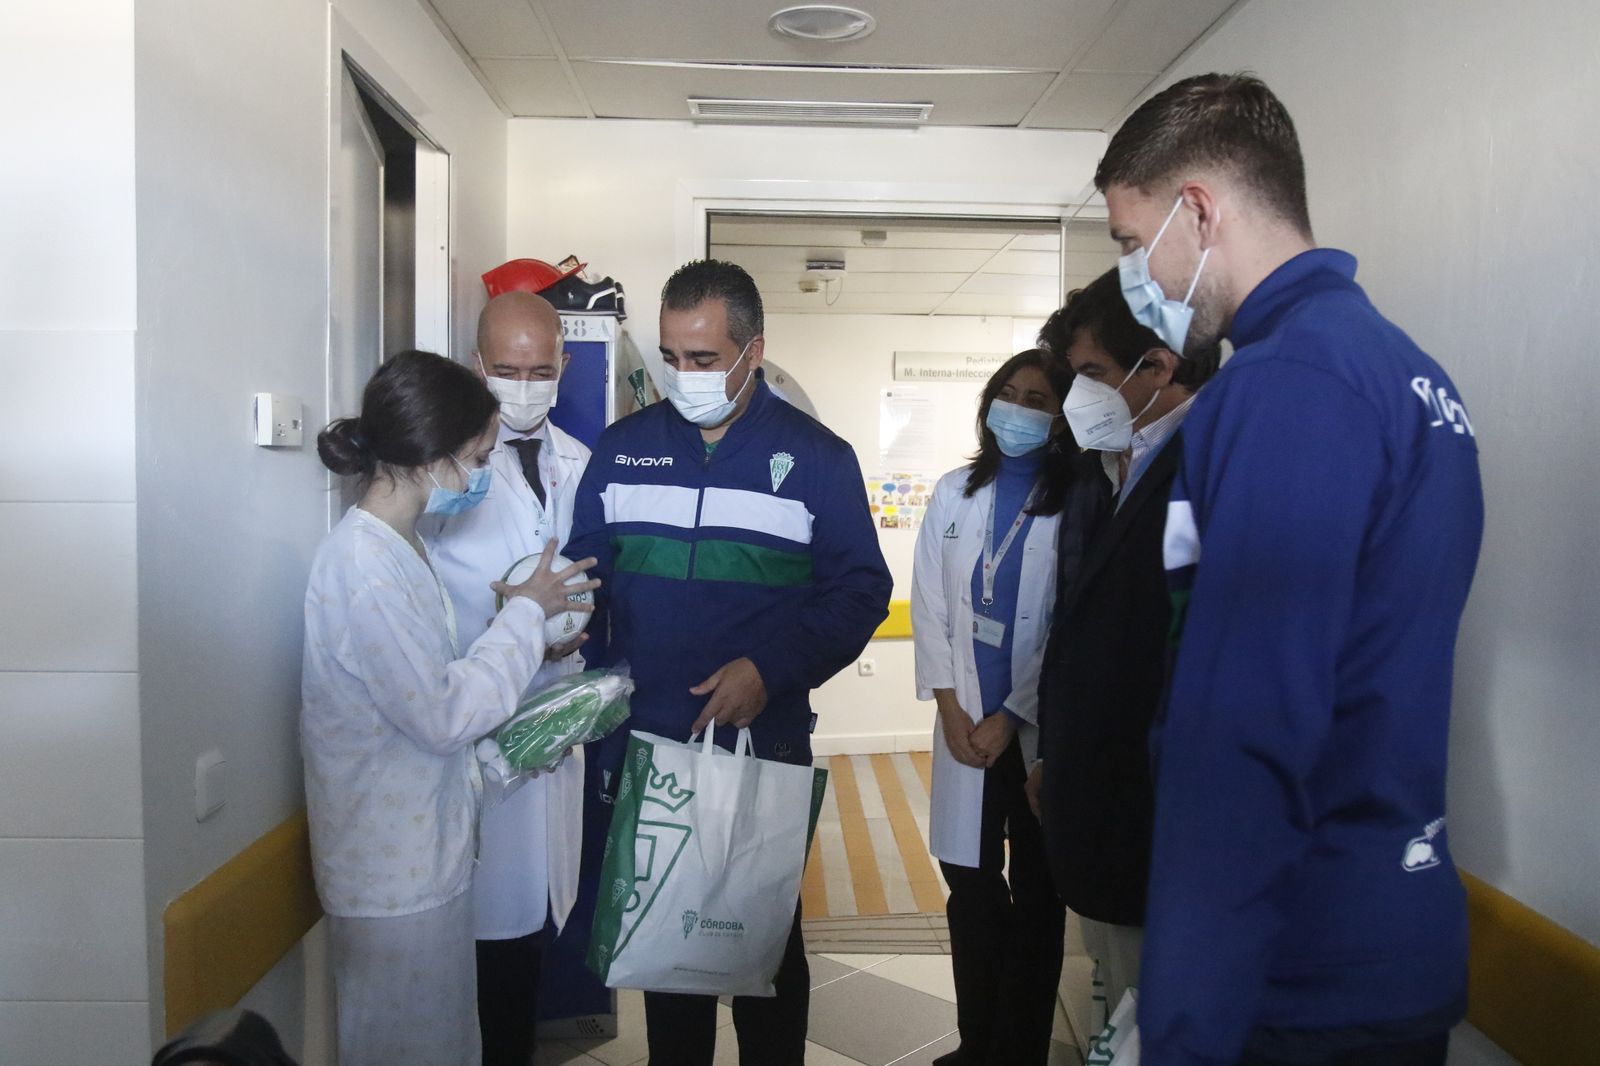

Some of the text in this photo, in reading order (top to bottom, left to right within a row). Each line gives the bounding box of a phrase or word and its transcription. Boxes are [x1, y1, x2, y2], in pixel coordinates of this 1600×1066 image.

[904, 368, 916, 377] M.
[615, 454, 674, 467] GIVOVA
[700, 918, 745, 931] CÓRDOBA
